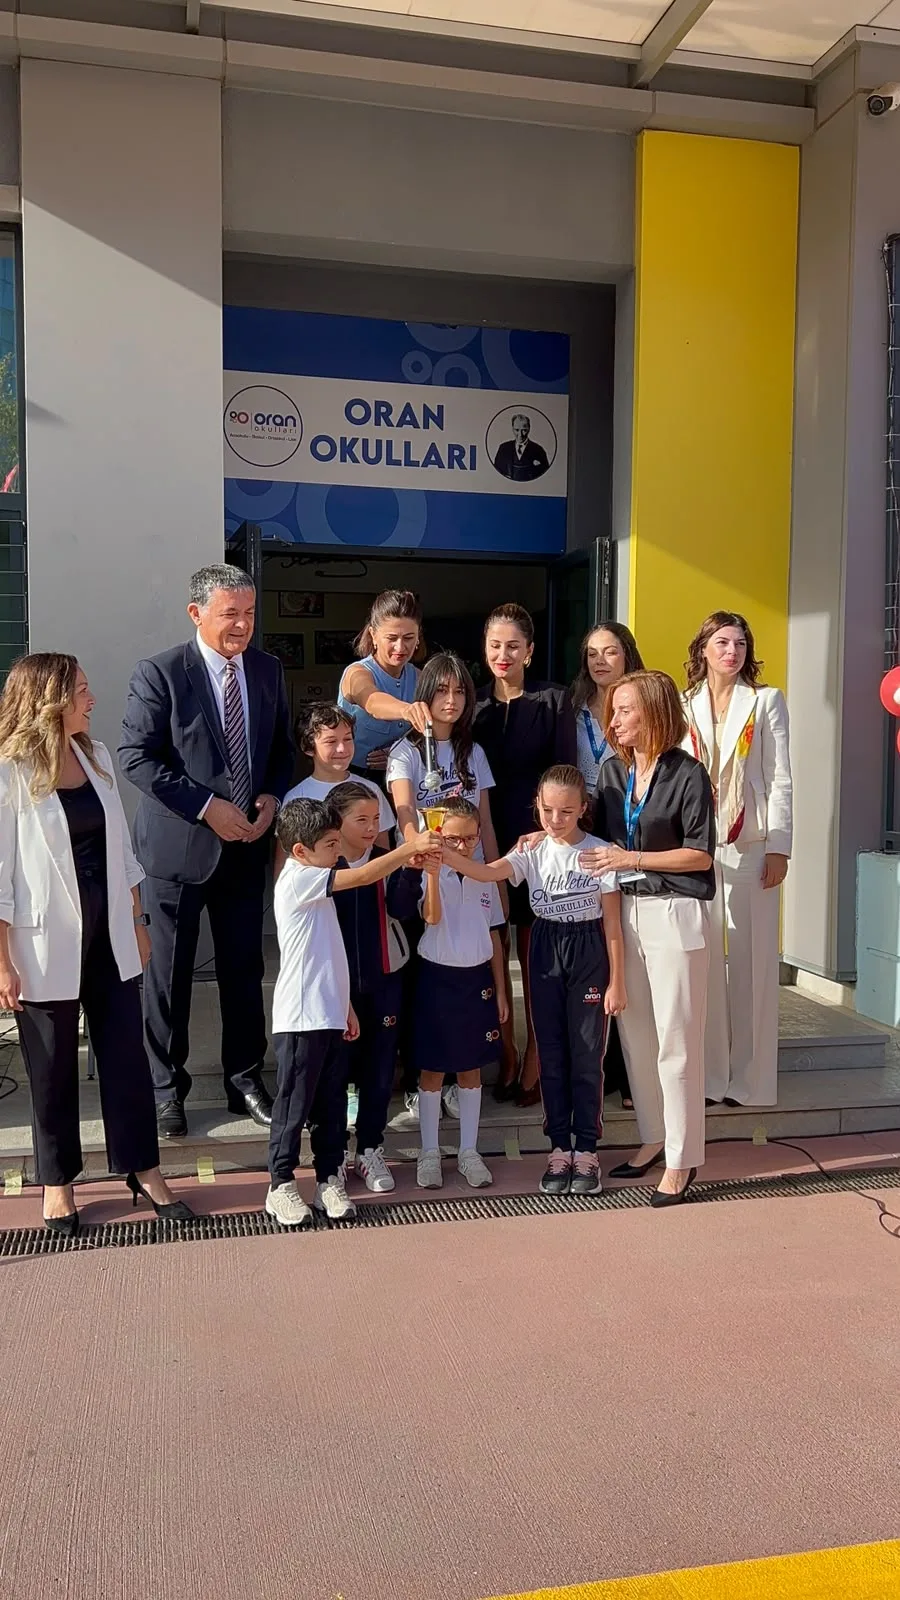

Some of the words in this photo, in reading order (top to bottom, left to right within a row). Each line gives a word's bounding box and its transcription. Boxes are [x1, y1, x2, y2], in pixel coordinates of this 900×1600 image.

[254, 413, 297, 427] oran
[254, 426, 297, 434] okulları
[344, 398, 445, 431] ORAN
[309, 434, 477, 471] OKULLARI
[531, 870, 600, 907] Athletic
